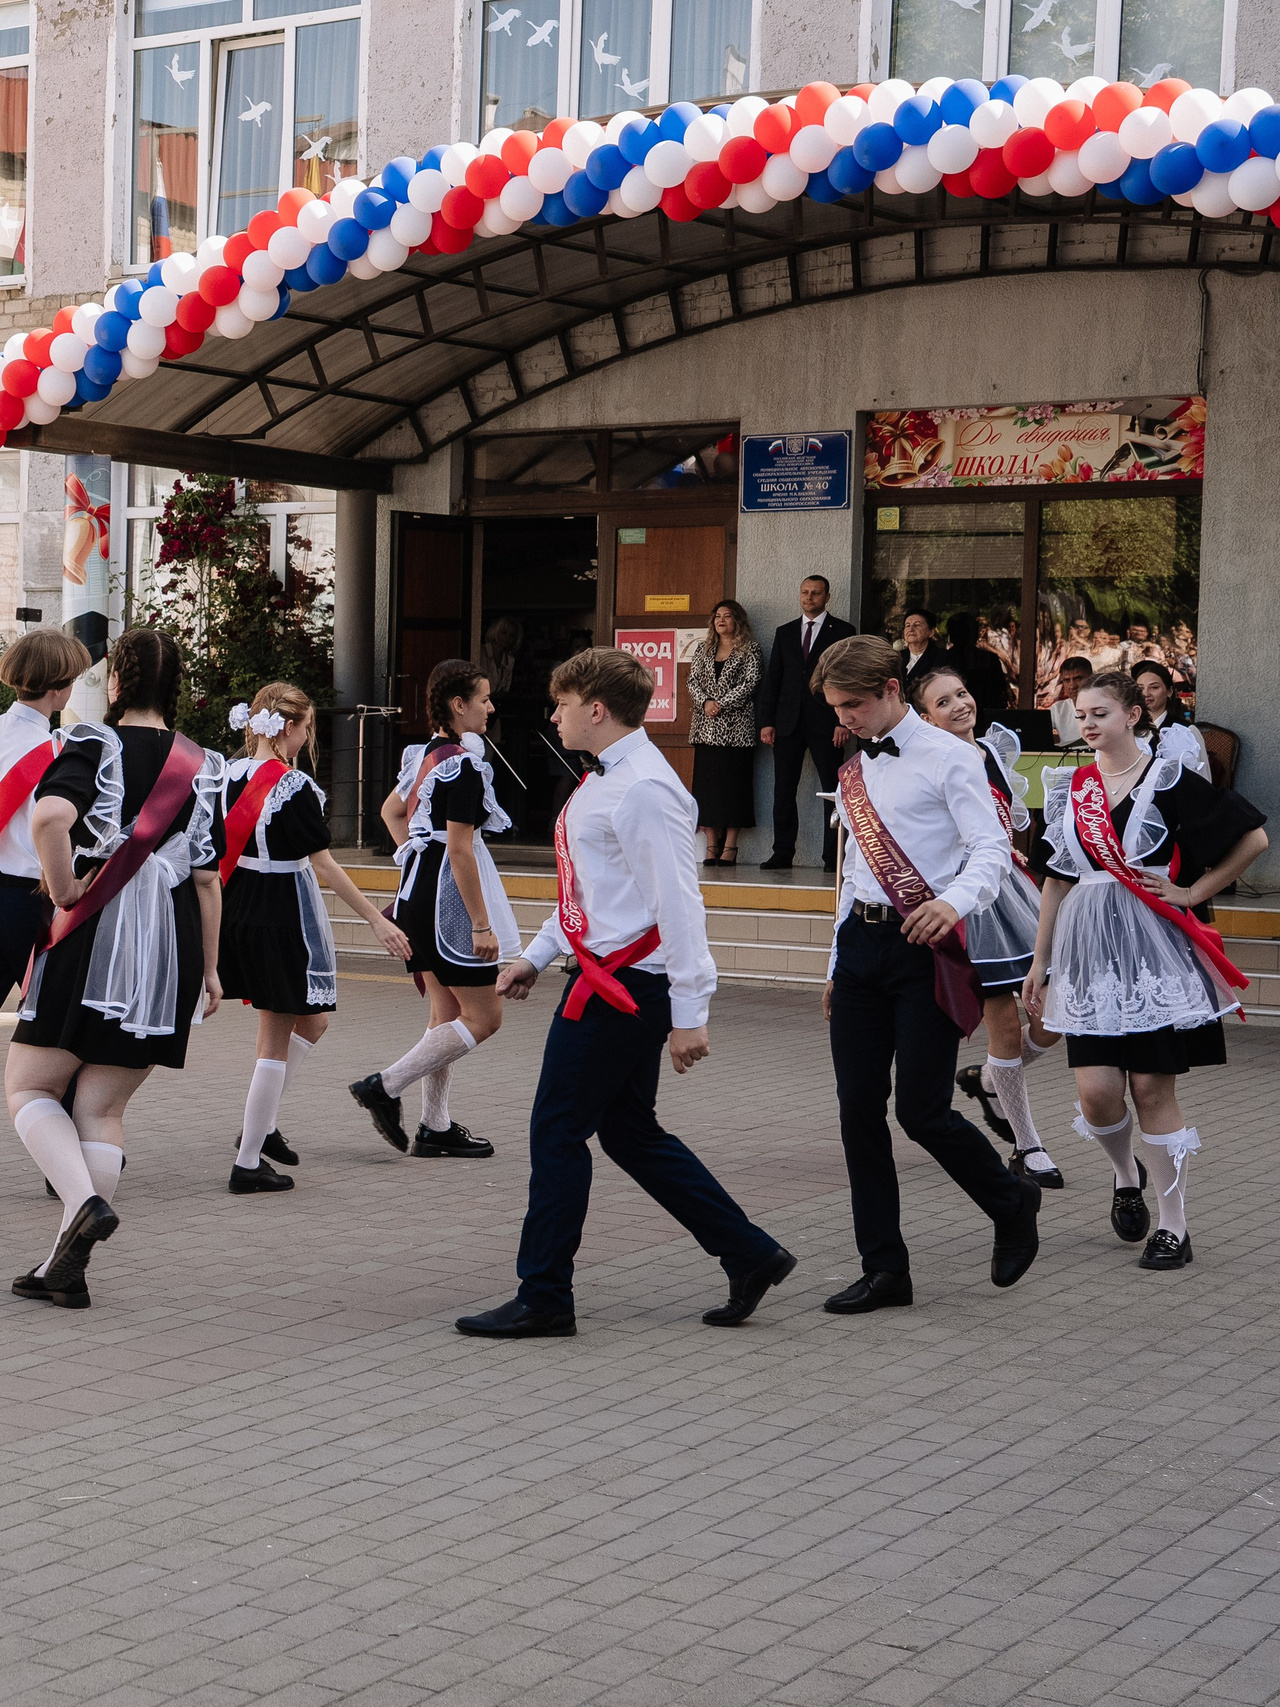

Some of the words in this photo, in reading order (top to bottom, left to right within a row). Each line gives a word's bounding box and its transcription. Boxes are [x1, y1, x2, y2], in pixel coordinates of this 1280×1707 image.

[956, 420, 1002, 450] До
[953, 454, 1039, 477] ШКОЛА!
[760, 482, 798, 492] ШКОЛА
[815, 481, 829, 490] 40
[621, 642, 672, 660] ВХОД
[649, 698, 670, 709] аж
[846, 781, 898, 874] Выпускник
[886, 866, 932, 906] 2025
[563, 900, 583, 934] 2025
